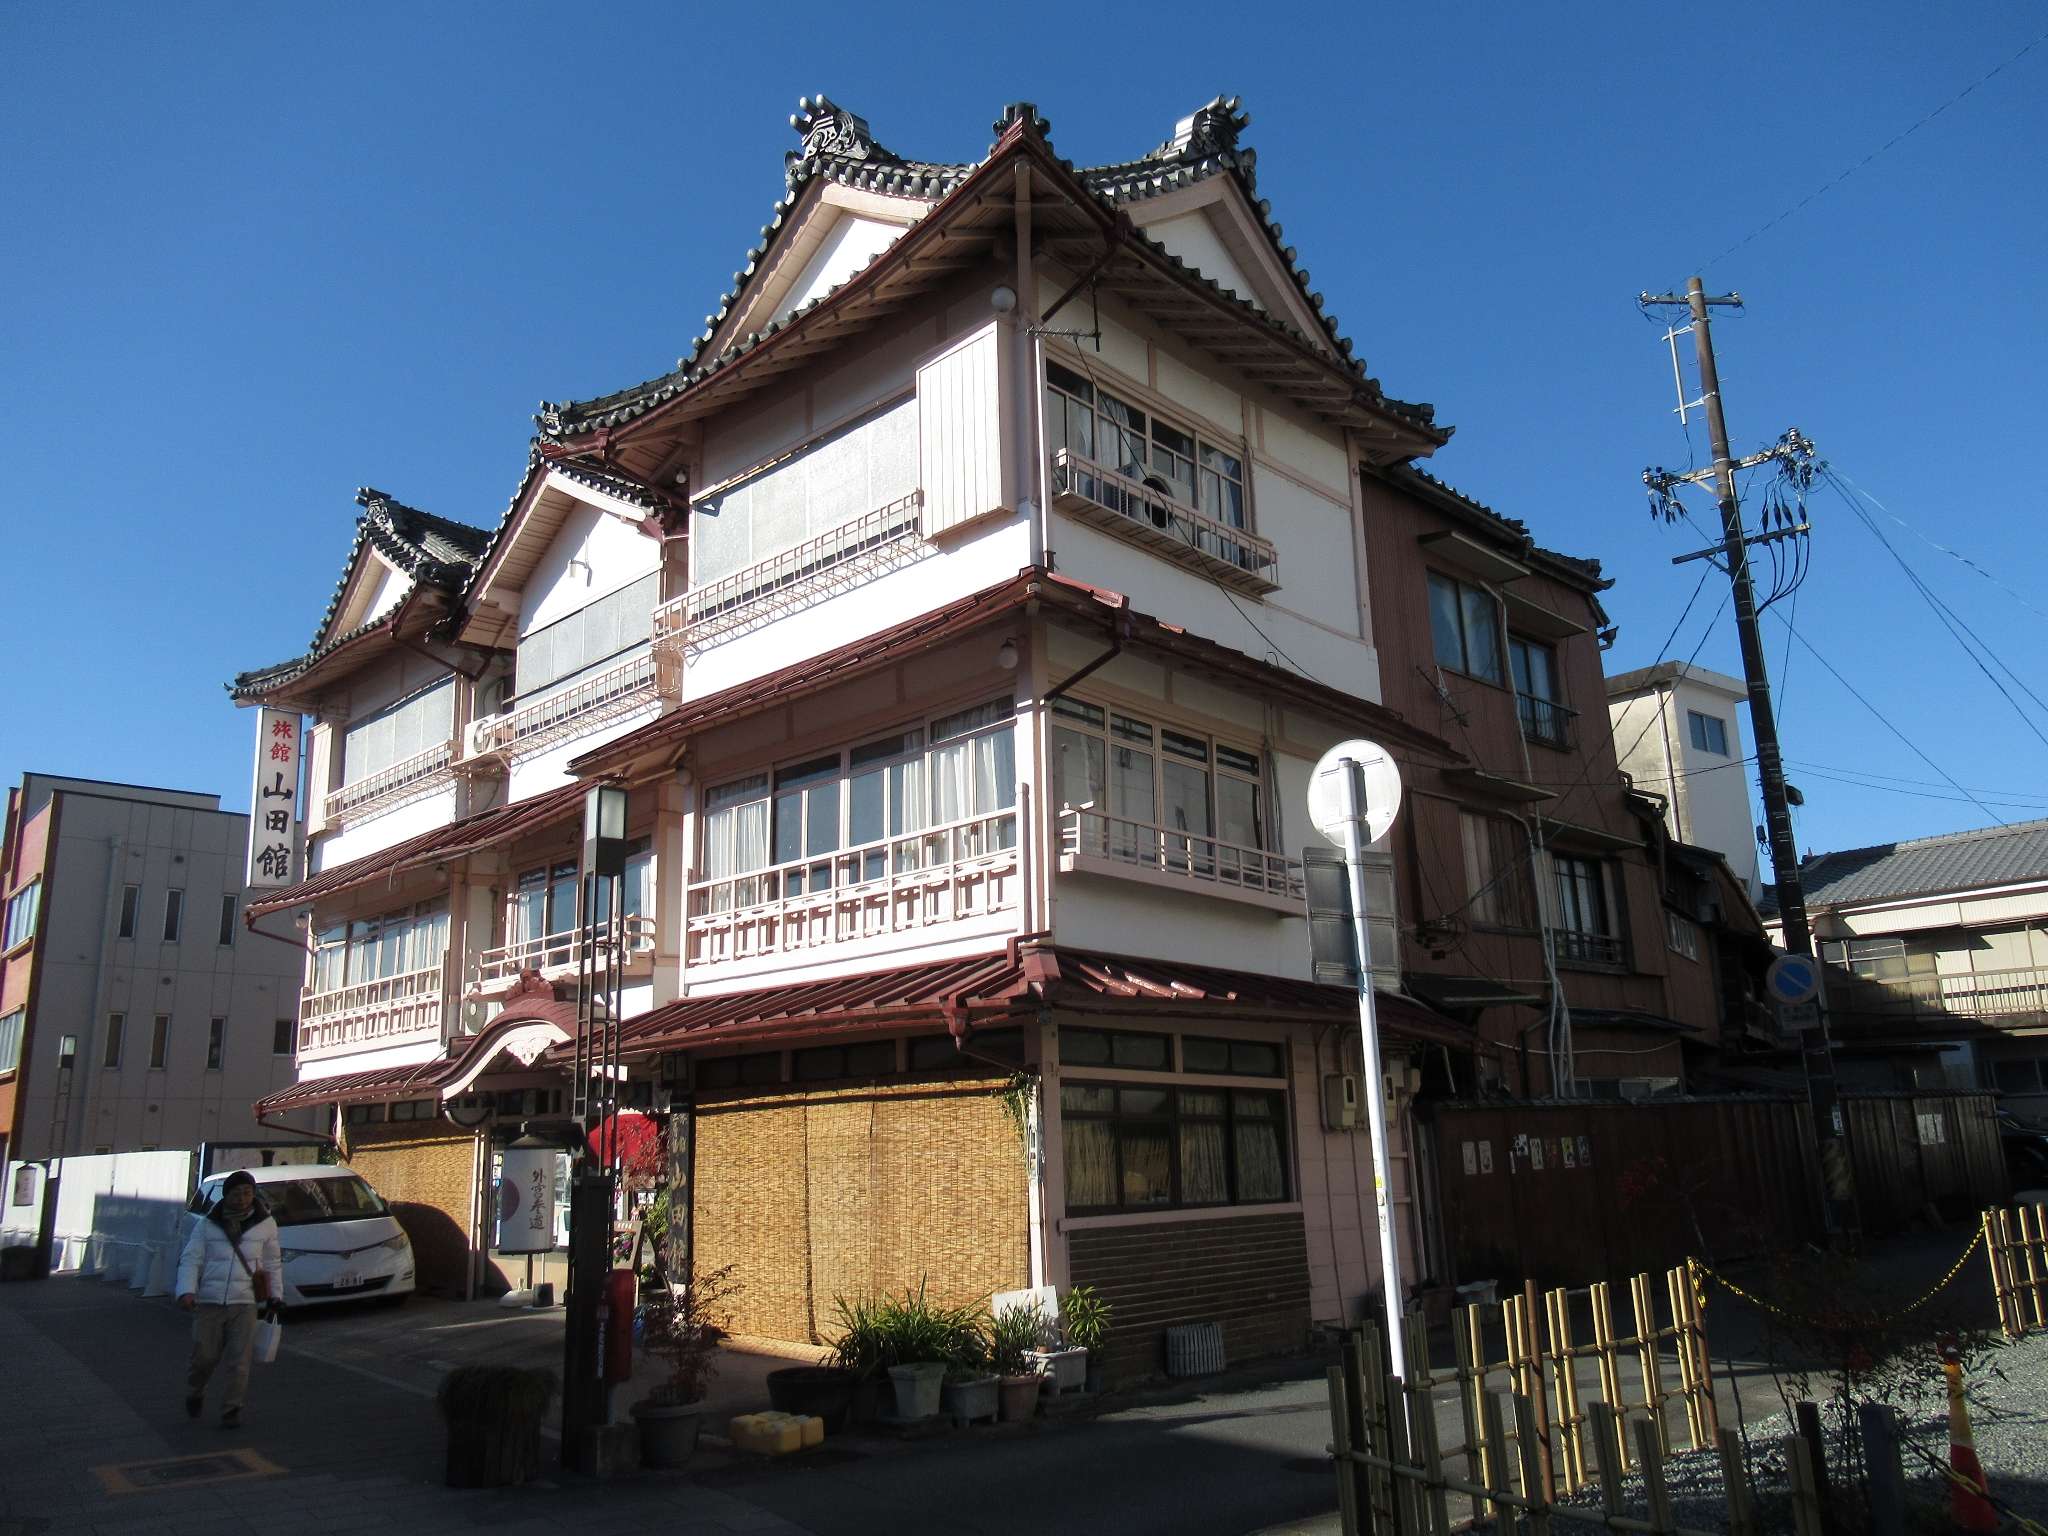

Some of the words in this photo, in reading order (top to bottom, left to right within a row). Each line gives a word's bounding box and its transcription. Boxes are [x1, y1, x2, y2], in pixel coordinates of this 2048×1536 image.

[270, 719, 293, 763] 旅館
[257, 771, 293, 880] 山田館
[529, 1167, 546, 1231] 外宮参道
